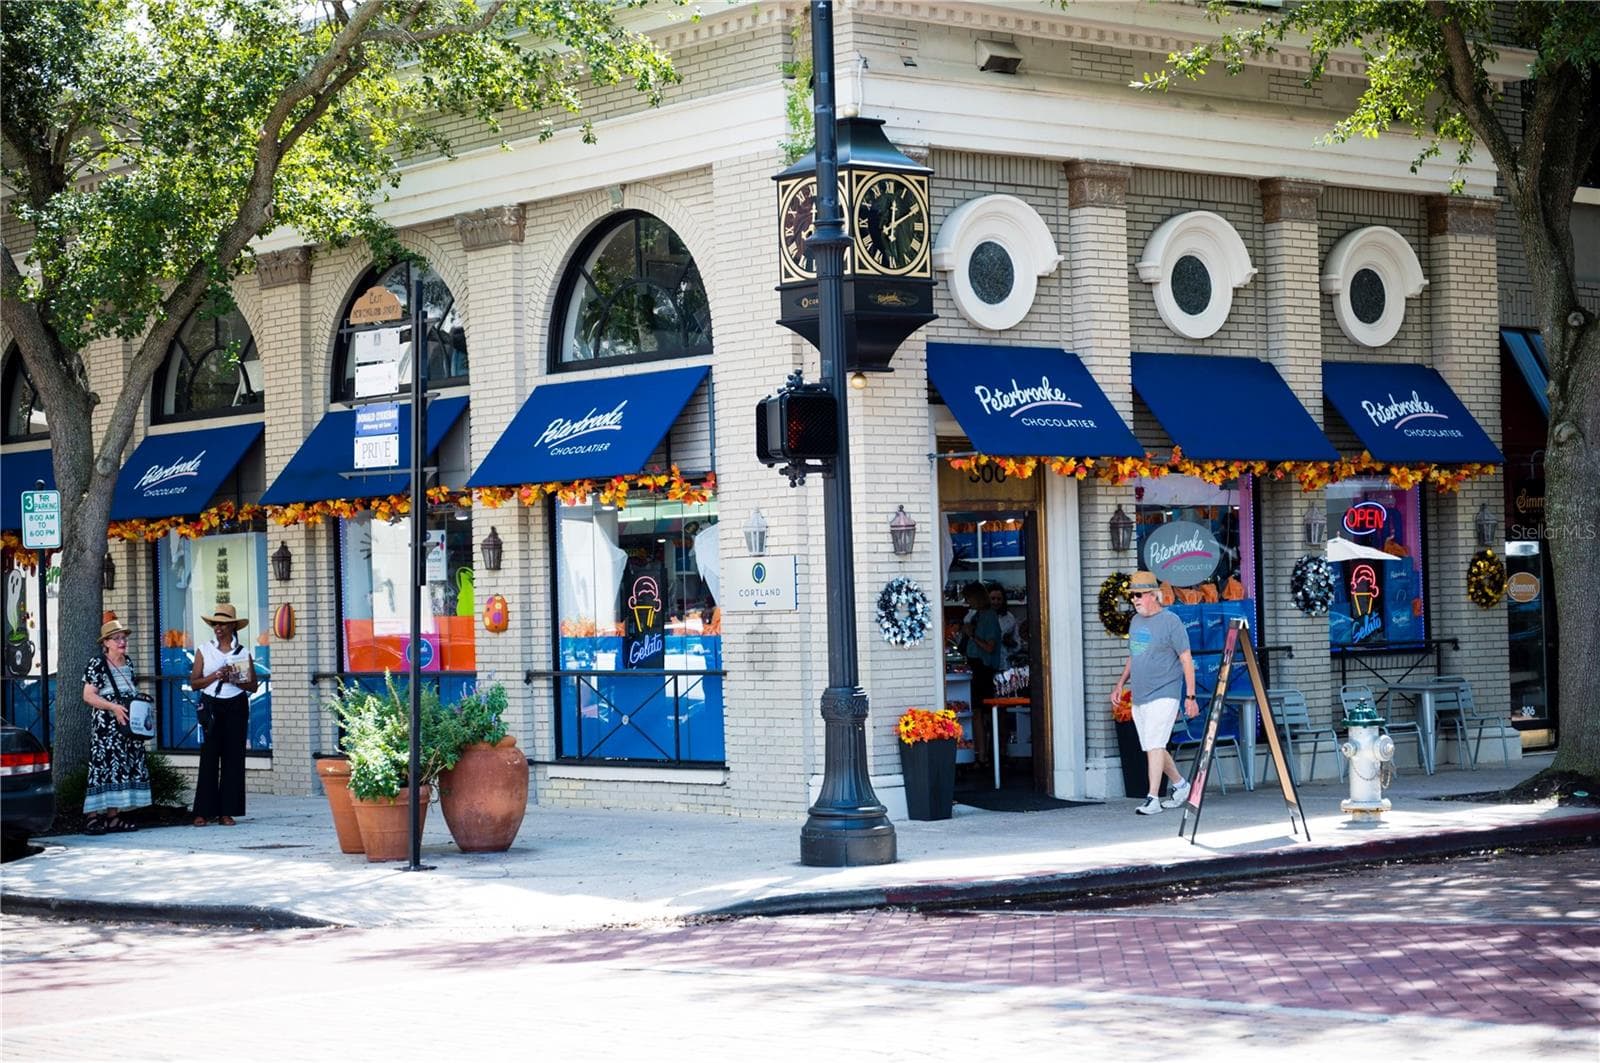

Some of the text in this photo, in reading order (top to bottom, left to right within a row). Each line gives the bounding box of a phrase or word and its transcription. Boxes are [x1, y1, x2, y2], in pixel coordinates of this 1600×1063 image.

[974, 375, 1067, 415] Peterbrooke
[1361, 390, 1435, 427] Peterbrooke
[534, 399, 628, 448] Peterbrooke
[1021, 417, 1098, 429] CHOCOLATIER
[1403, 428, 1464, 438] CHOCOLATIER
[550, 442, 611, 456] CHOCOLATIER
[133, 450, 207, 490] Peterbrooke
[143, 486, 188, 497] CHOCOLATIER
[25, 495, 34, 510] 3
[34, 502, 58, 510] PARKING
[38, 521, 47, 529] TO
[1347, 507, 1384, 529] OPEN
[1150, 529, 1206, 568] Peterbrooke
[738, 588, 781, 598] CORTLAND
[630, 633, 662, 664] Gelato
